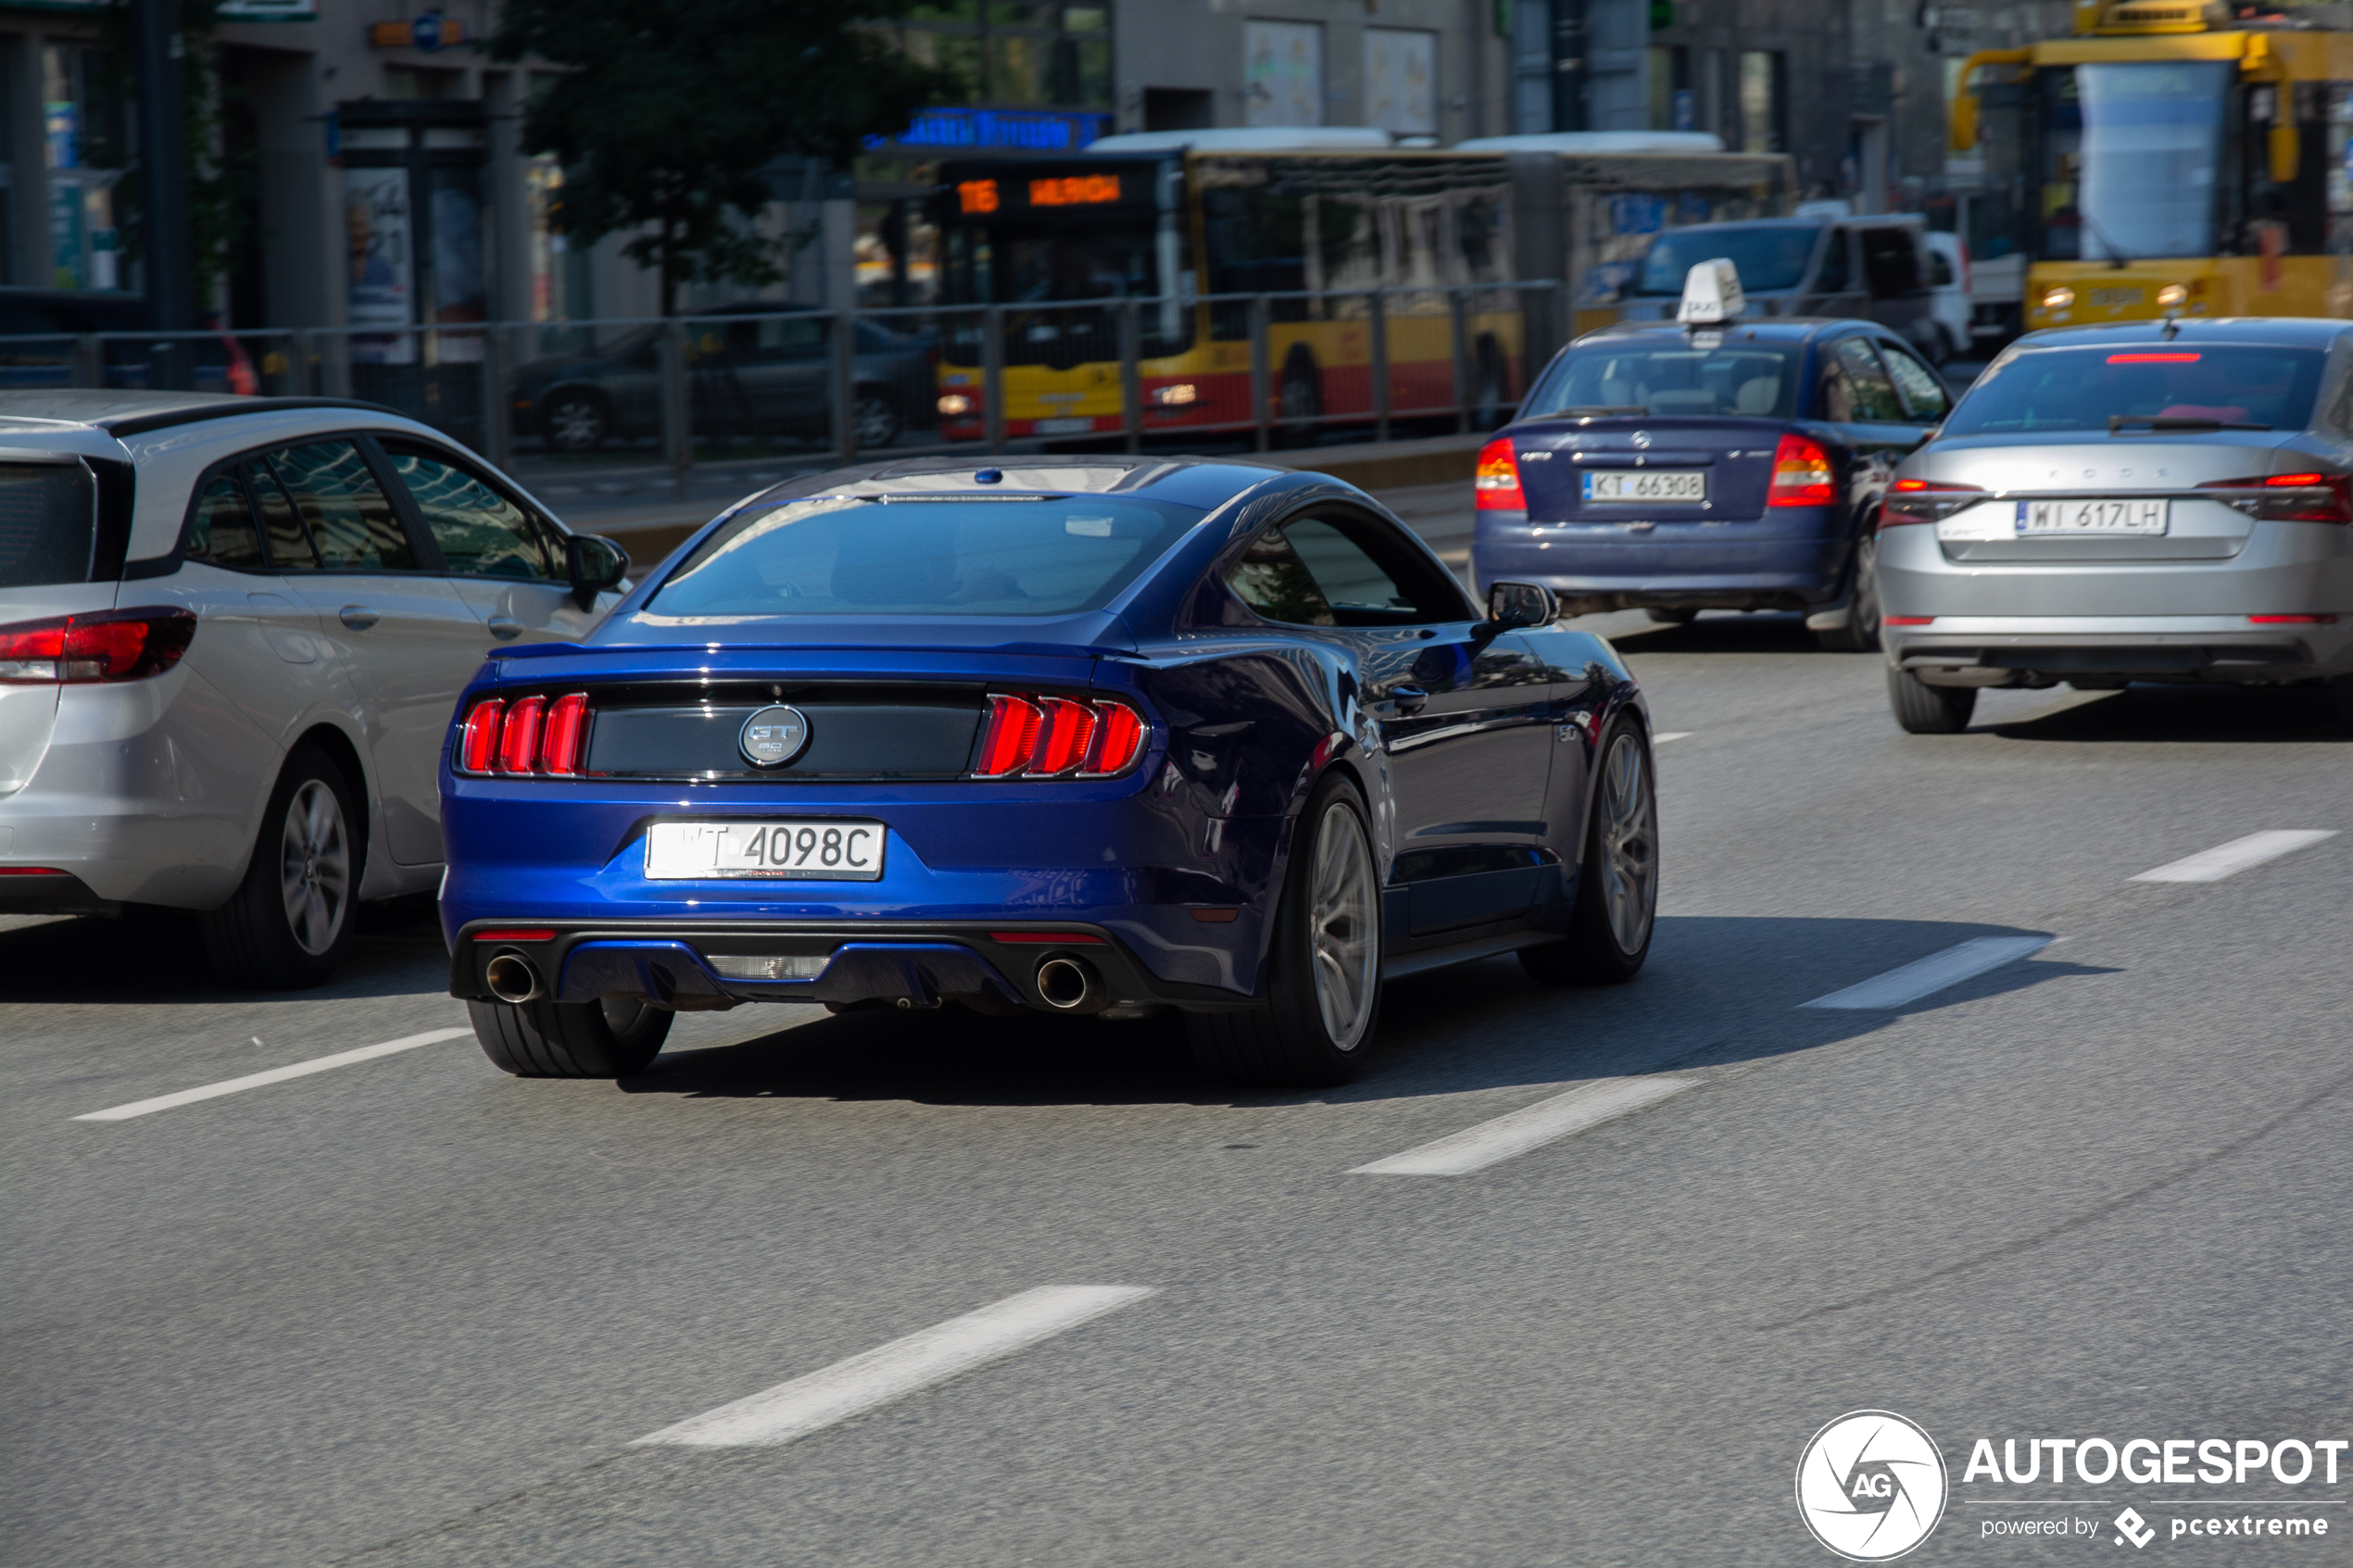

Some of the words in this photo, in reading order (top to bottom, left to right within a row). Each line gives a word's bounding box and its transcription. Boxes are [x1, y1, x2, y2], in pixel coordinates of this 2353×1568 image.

[1595, 475, 1623, 496] KT
[1635, 475, 1702, 496] 66308
[2032, 502, 2063, 528] WI
[2075, 502, 2160, 527] 617LH
[748, 724, 799, 739] GT
[744, 826, 871, 867] 4098C
